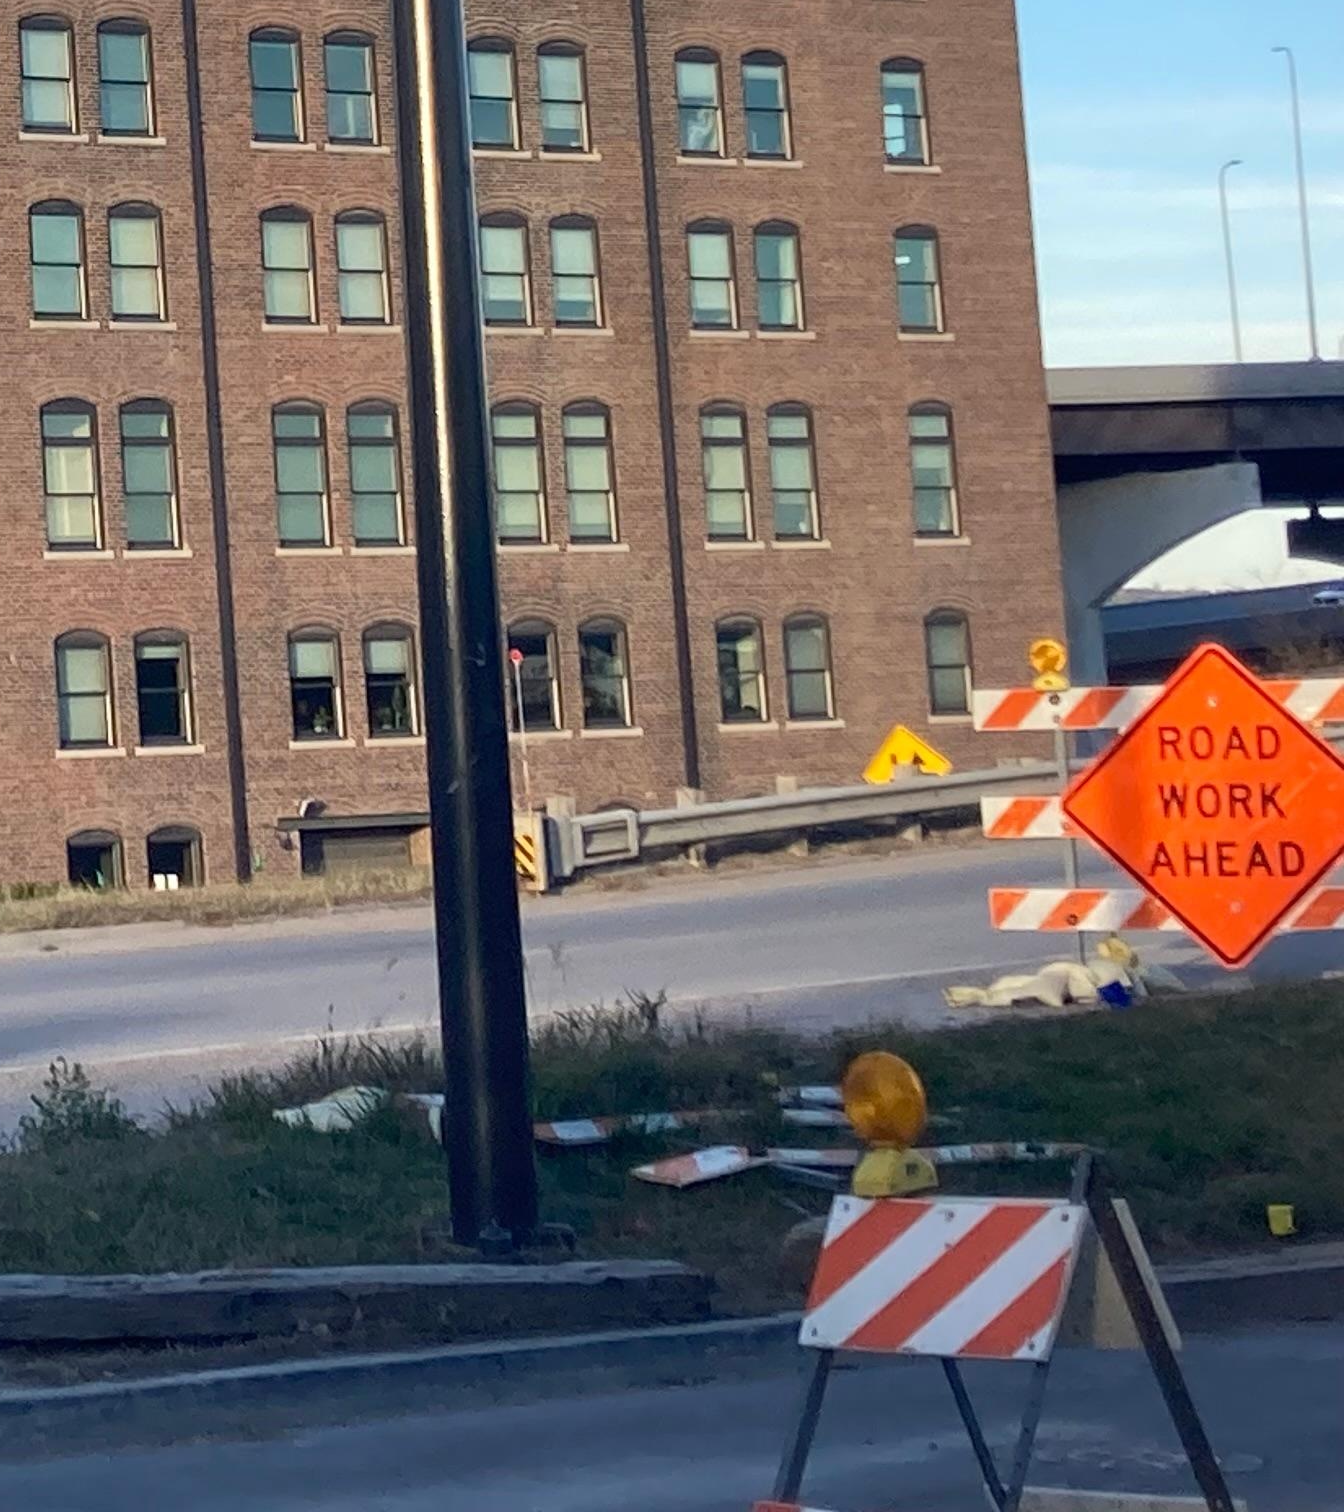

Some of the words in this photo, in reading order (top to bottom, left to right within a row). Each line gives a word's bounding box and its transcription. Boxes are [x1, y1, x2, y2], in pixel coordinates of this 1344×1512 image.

[1158, 726, 1282, 761] ROAD
[1159, 783, 1287, 819] WORK
[1148, 840, 1305, 877] AHEAD
